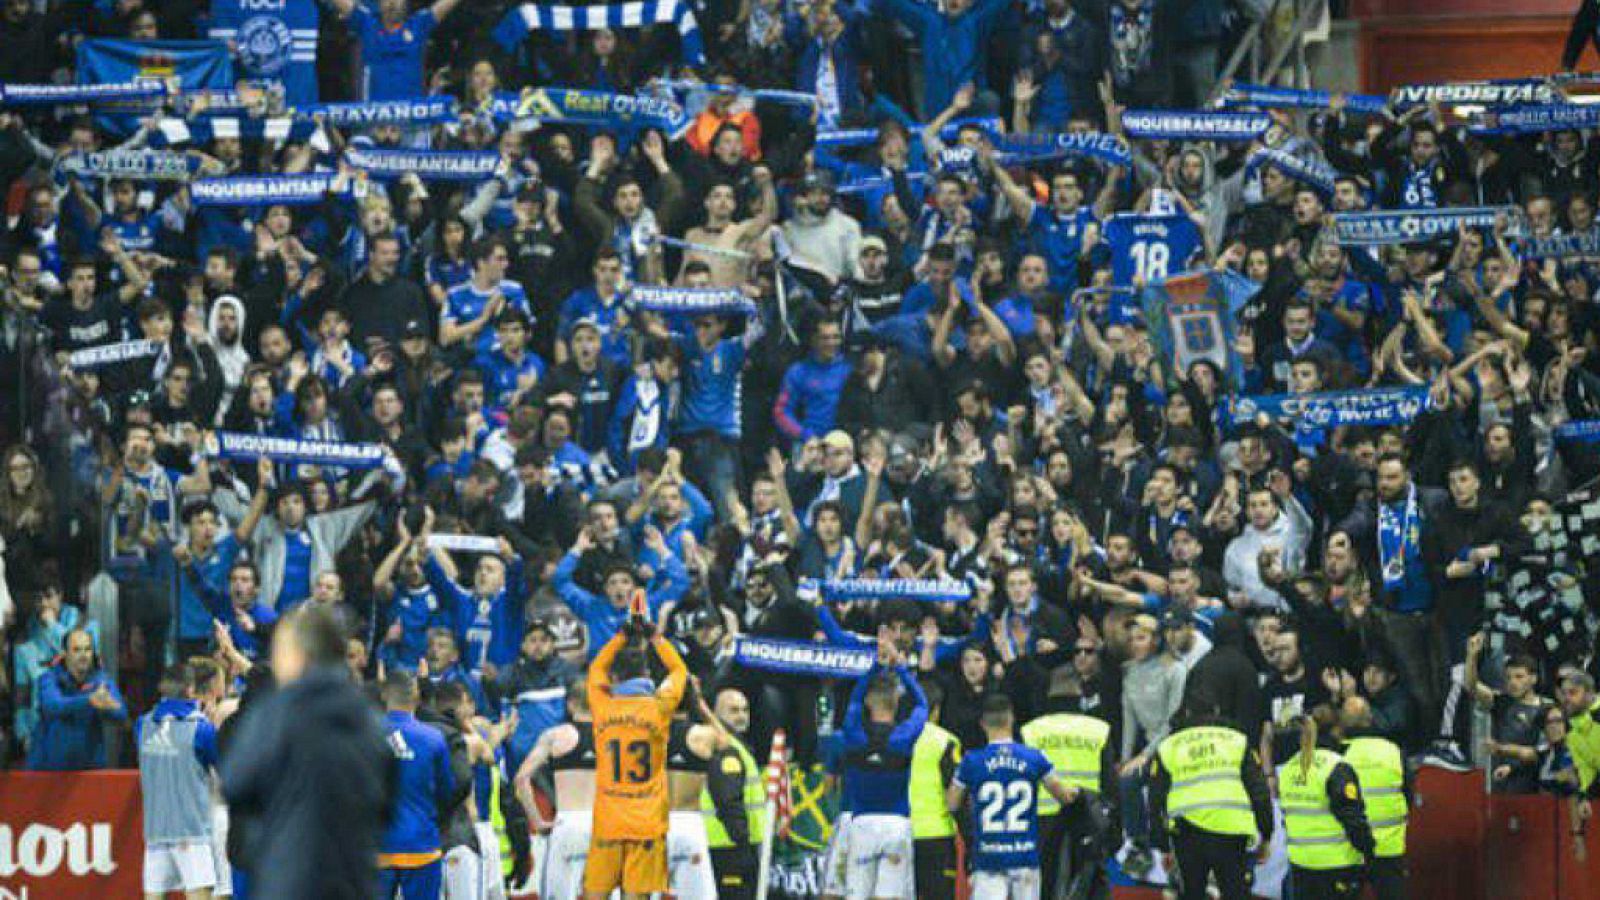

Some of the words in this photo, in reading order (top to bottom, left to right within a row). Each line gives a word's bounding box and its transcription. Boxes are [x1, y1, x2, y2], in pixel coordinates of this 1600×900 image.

[1130, 242, 1171, 283] 18
[604, 738, 652, 783] 13
[977, 780, 1034, 833] 22
